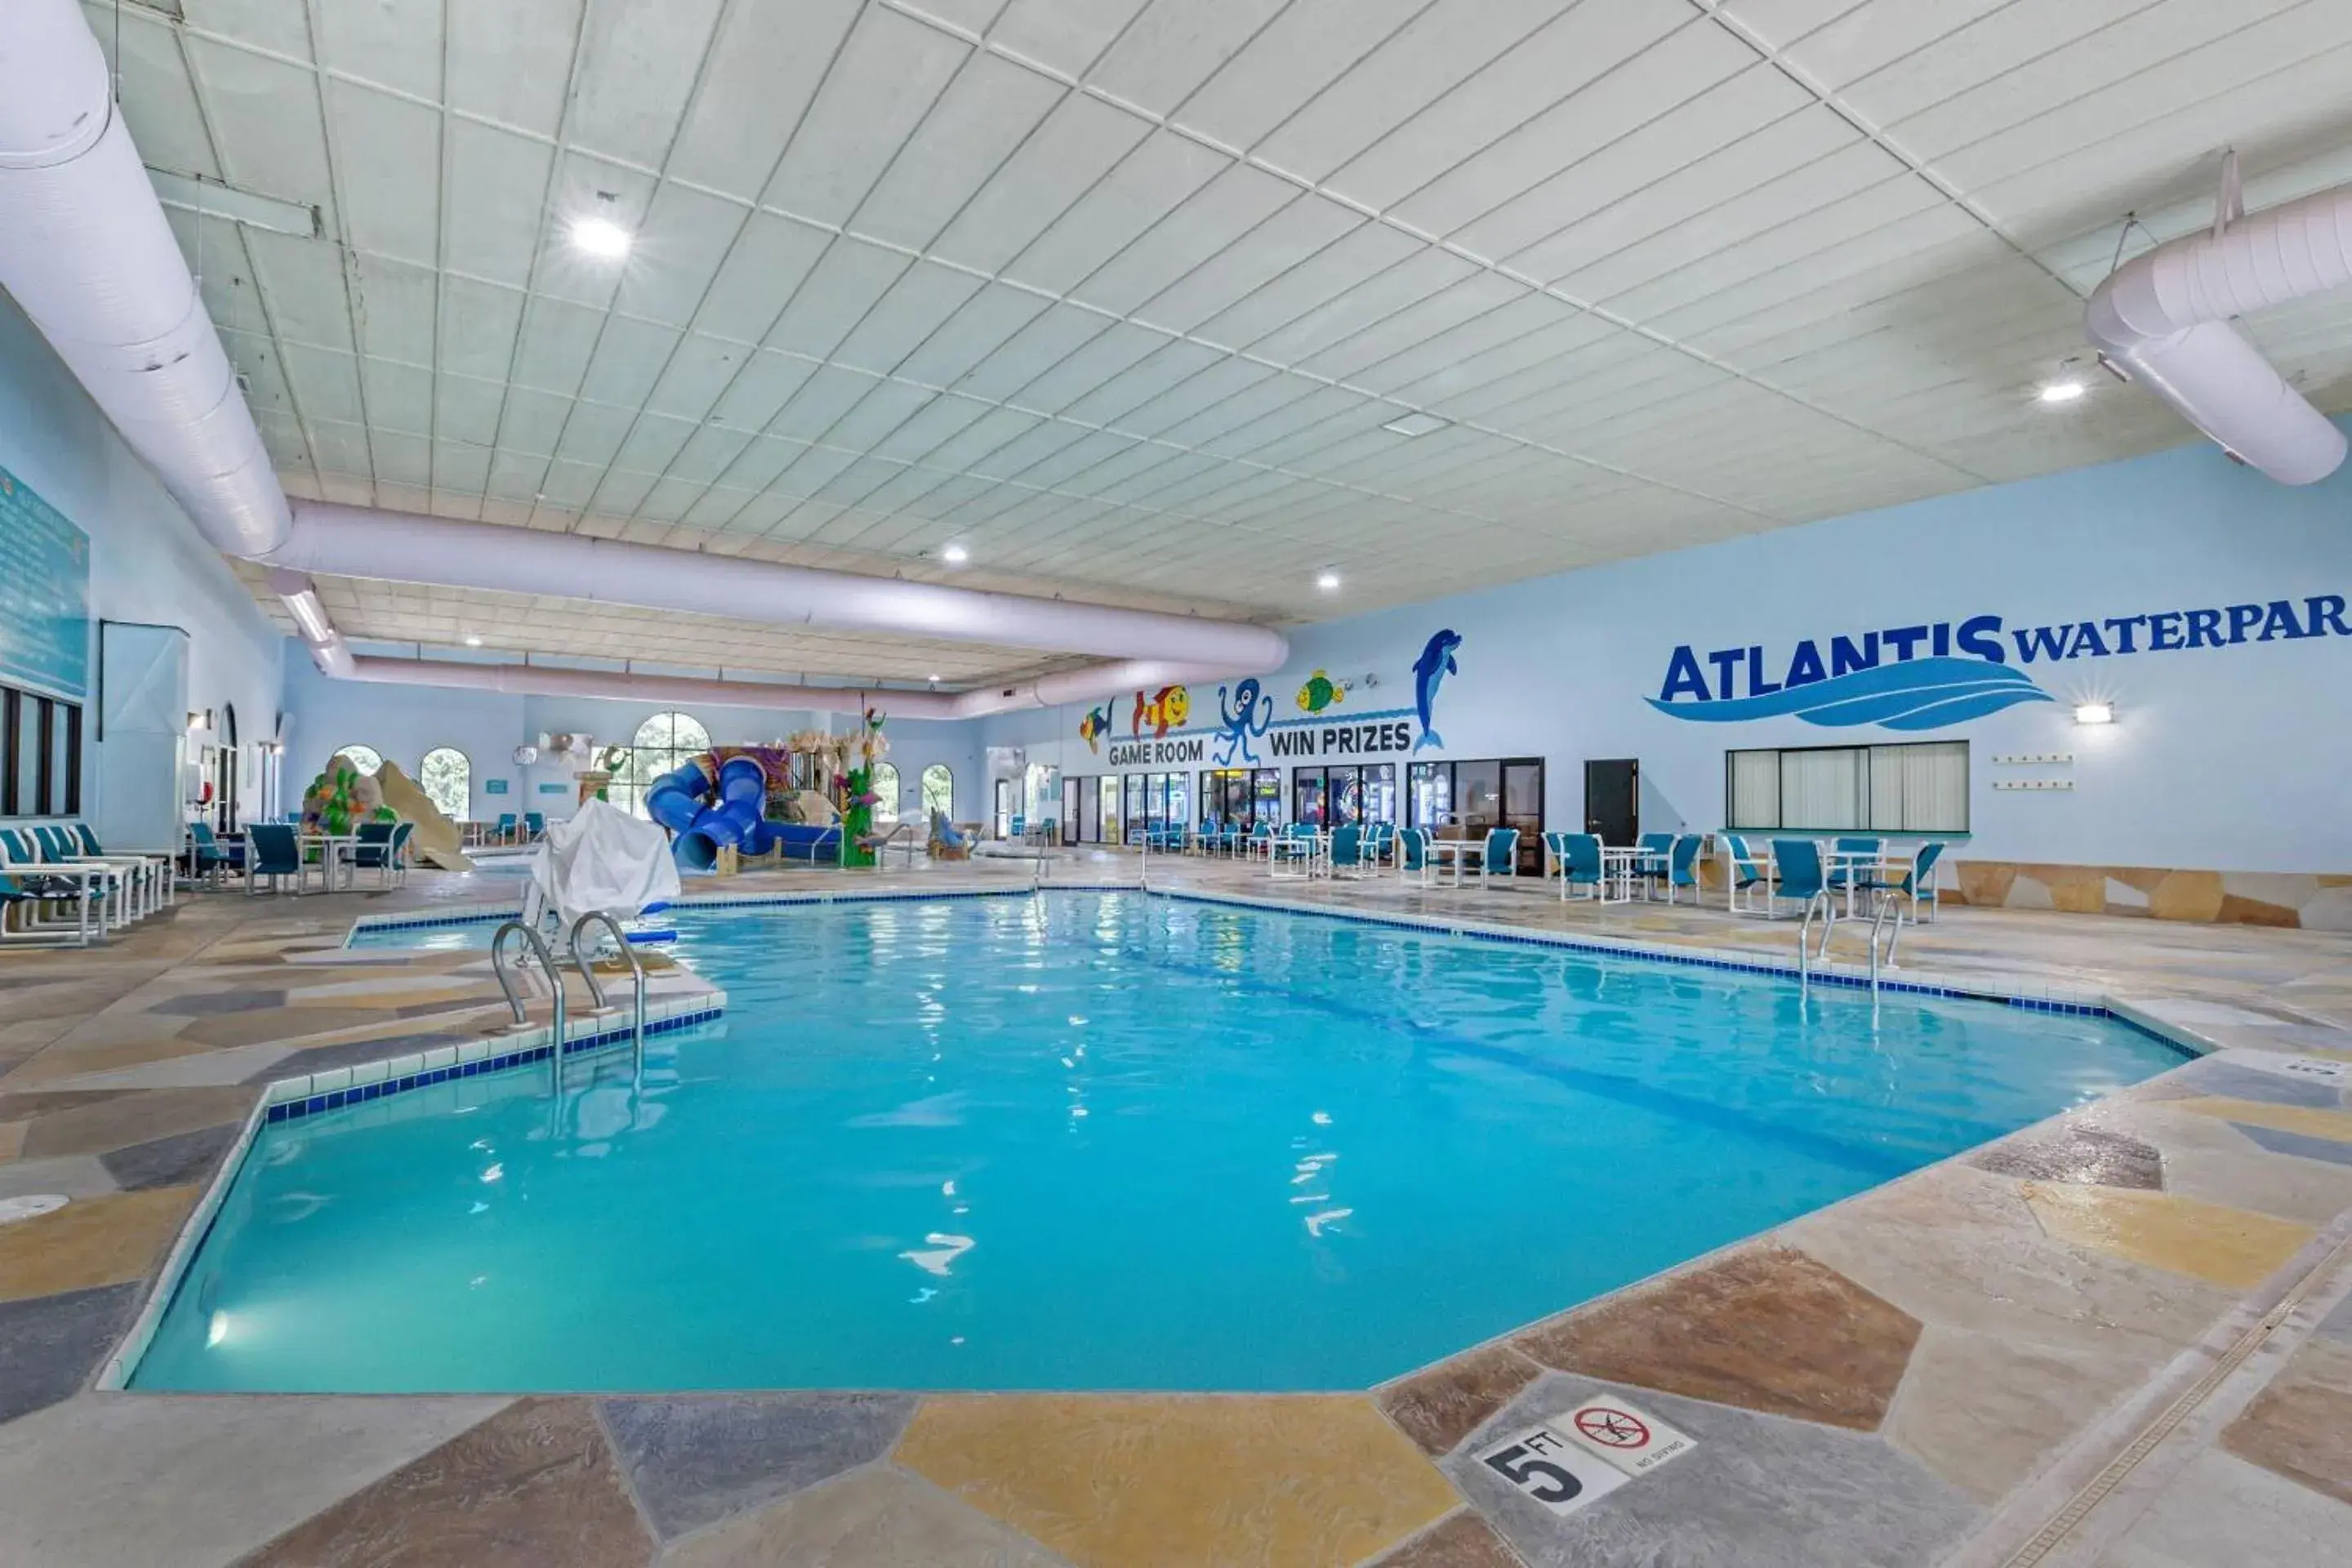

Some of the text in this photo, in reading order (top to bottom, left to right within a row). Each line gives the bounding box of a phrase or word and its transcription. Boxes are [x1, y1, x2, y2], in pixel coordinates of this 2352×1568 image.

[1659, 595, 2352, 702] ATLANTIS WATERPAR
[1109, 740, 1204, 766] GAME ROOM
[1270, 722, 1411, 757] WIN PRIZES
[1484, 1431, 1583, 1503] 5 FT
